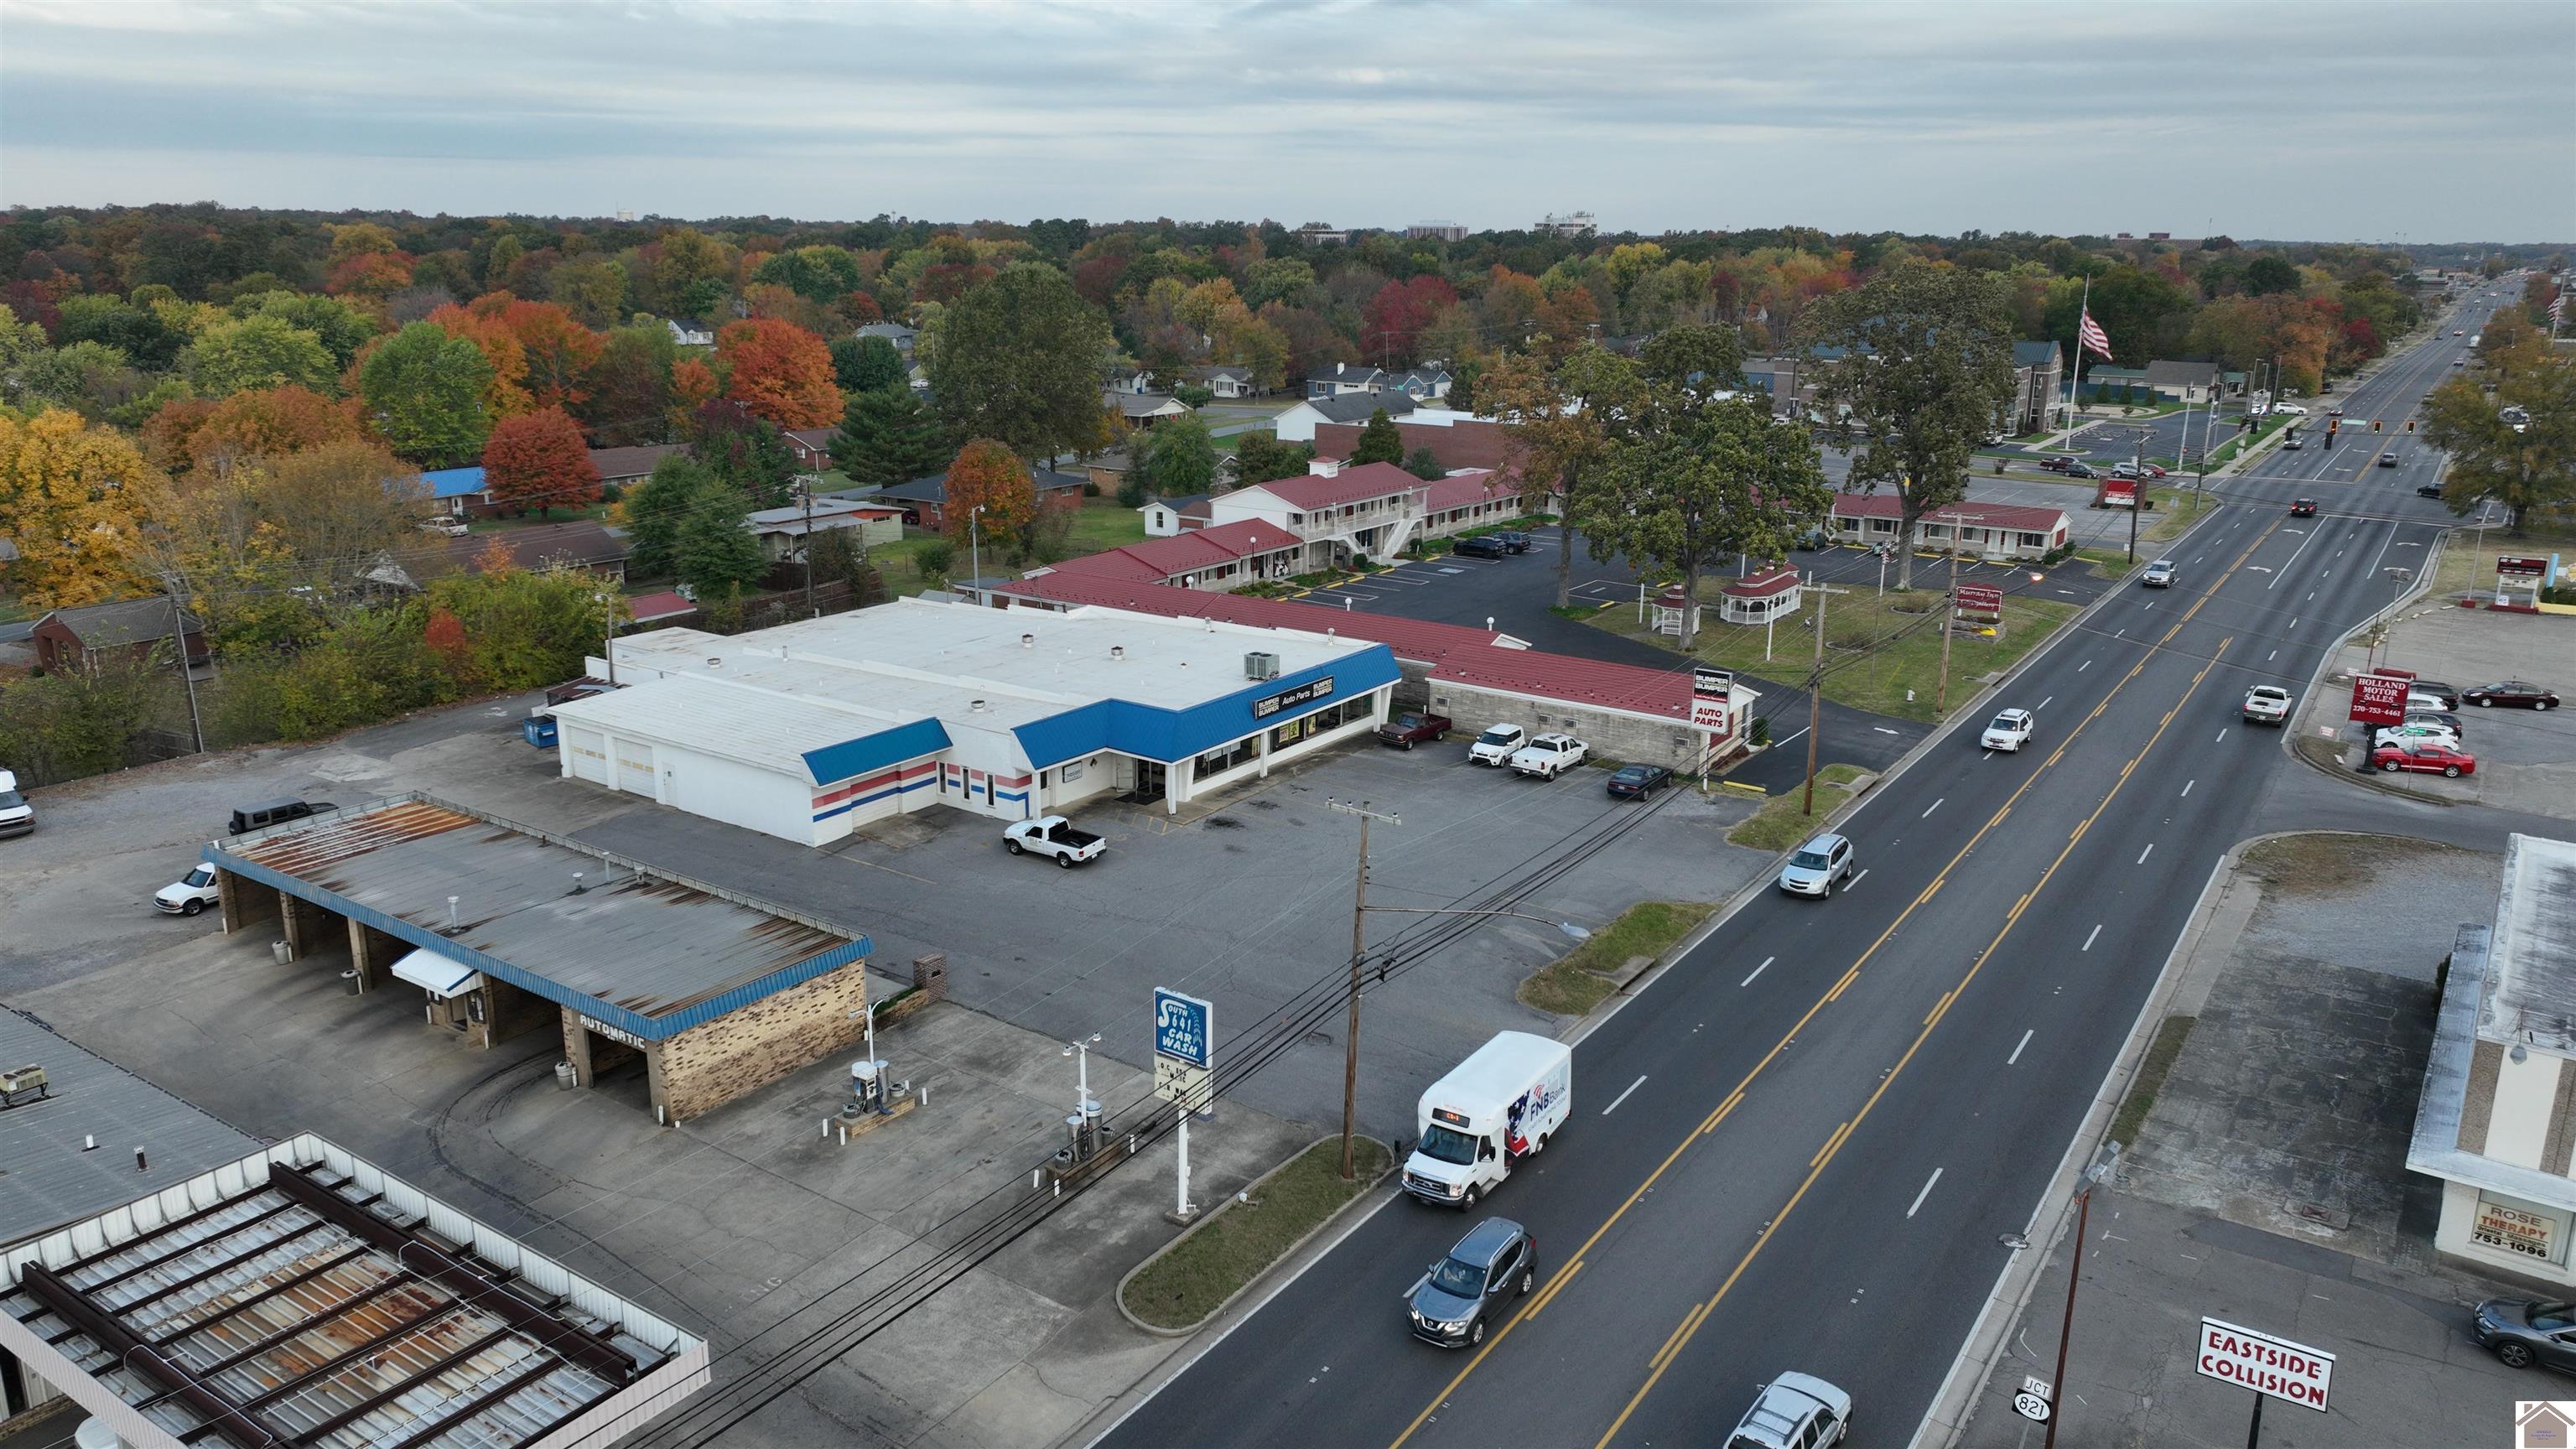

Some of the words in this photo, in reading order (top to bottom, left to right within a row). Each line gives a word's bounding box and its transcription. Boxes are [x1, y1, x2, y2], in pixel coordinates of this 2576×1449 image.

[1959, 589, 1985, 600] Murray
[1313, 678, 1332, 690] BUMPER
[1695, 683, 1728, 693] BUMPER
[1696, 674, 1728, 686] BUMPER
[2358, 678, 2406, 690] HOLLAND
[1282, 696, 1296, 706] Auto
[1296, 689, 1311, 701] Parts
[1313, 686, 1332, 698] BUMPER
[2362, 686, 2398, 697] MOTOR
[2364, 693, 2394, 704] SALES
[1258, 697, 1280, 709] BUMPER
[1258, 704, 1280, 717] BUMPER
[2352, 704, 2402, 717] 270-753-4461
[1696, 708, 1722, 718] AUTO
[1694, 717, 1723, 728] PARTS
[579, 1014, 645, 1049] AUTOMATIC
[1172, 1016, 1192, 1032] 641
[1168, 1028, 1192, 1045] CAR
[1162, 1036, 1197, 1057] WASH
[1530, 1092, 1549, 1121] FNB
[1550, 1083, 1566, 1104] Bank
[2490, 1207, 2542, 1228] ROSE
[2481, 1216, 2547, 1239] THERAPY
[2477, 1225, 2502, 1237] Oriental
[2507, 1233, 2547, 1248] Massages
[2474, 1232, 2547, 1258] 753-1096
[2209, 1331, 2322, 1379] EASTSIDE
[2025, 1379, 2049, 1395] JCT
[2201, 1355, 2324, 1406] COLLISION
[2019, 1396, 2044, 1417] 821
